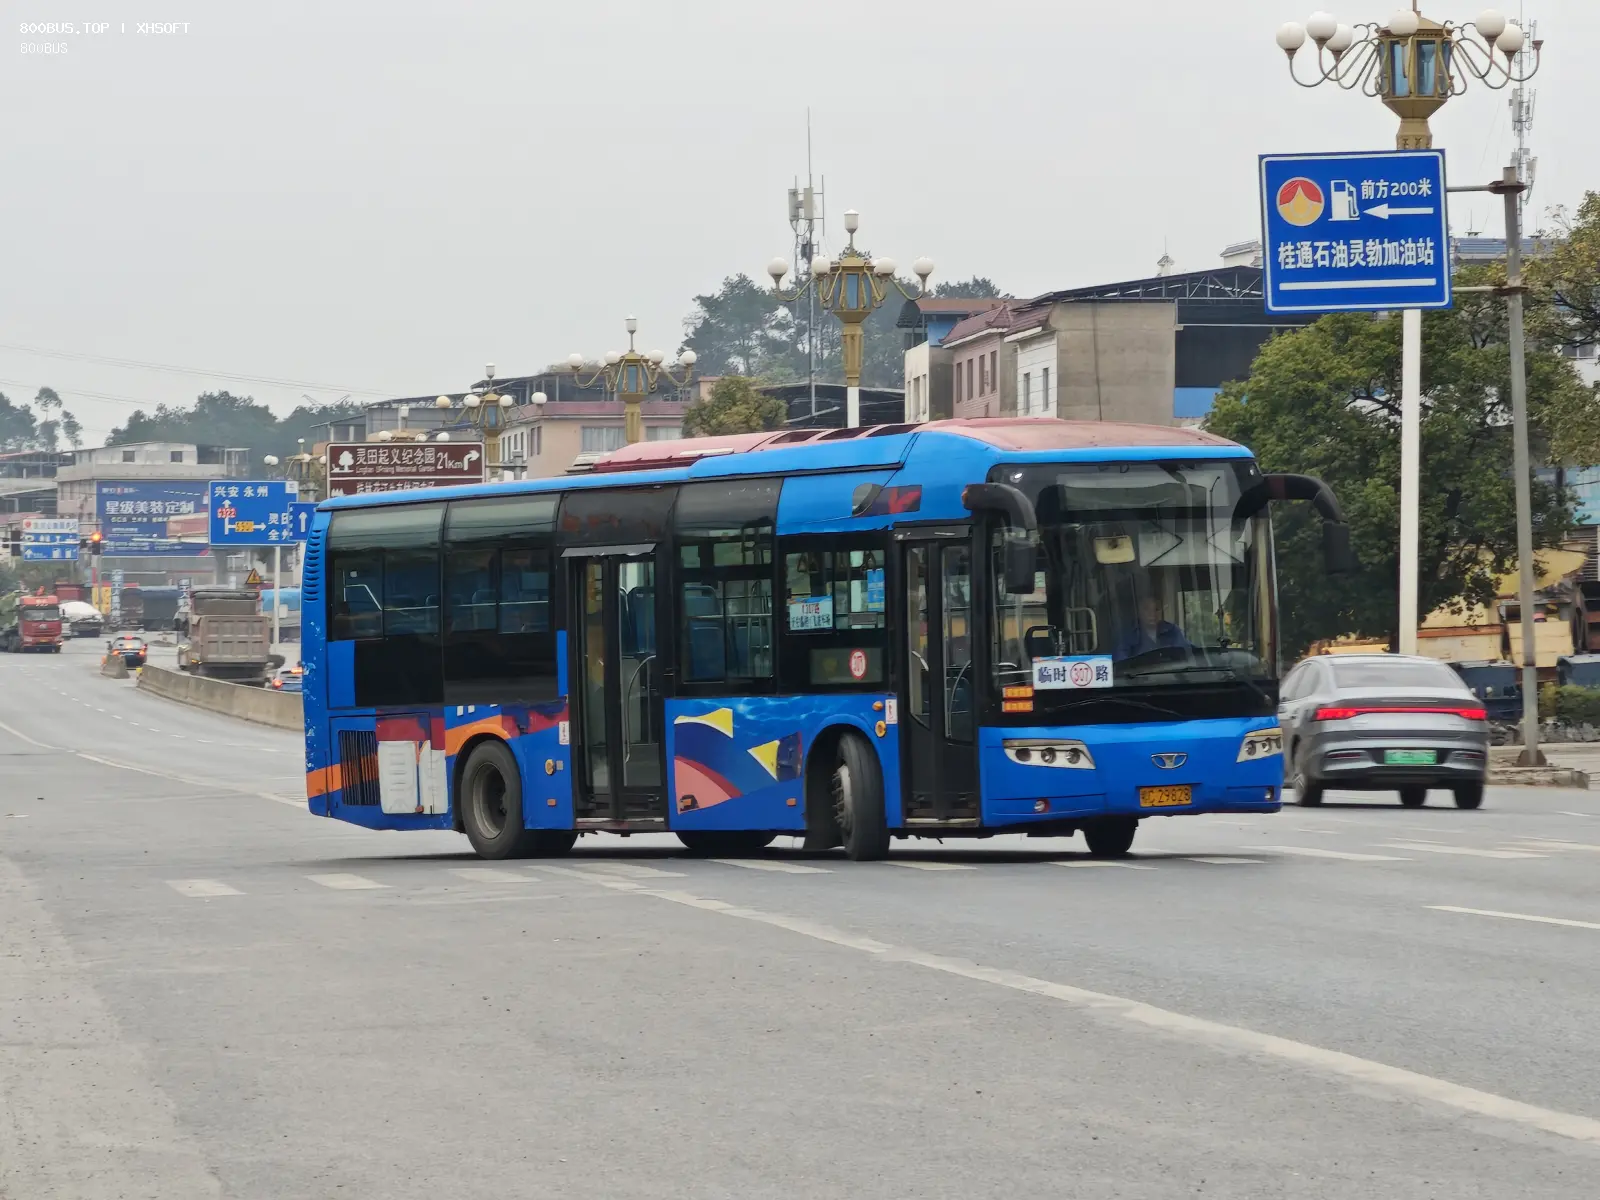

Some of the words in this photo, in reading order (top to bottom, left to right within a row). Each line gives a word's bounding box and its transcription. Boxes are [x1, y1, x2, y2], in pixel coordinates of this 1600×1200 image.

[1361, 177, 1433, 200] 前方200米
[1278, 236, 1435, 270] 桂通石油灵勃加油站
[356, 447, 436, 466] 灵田起义纪念园
[214, 485, 240, 498] 兴安
[243, 485, 269, 498] 永州
[105, 500, 195, 515] 星级美装定制
